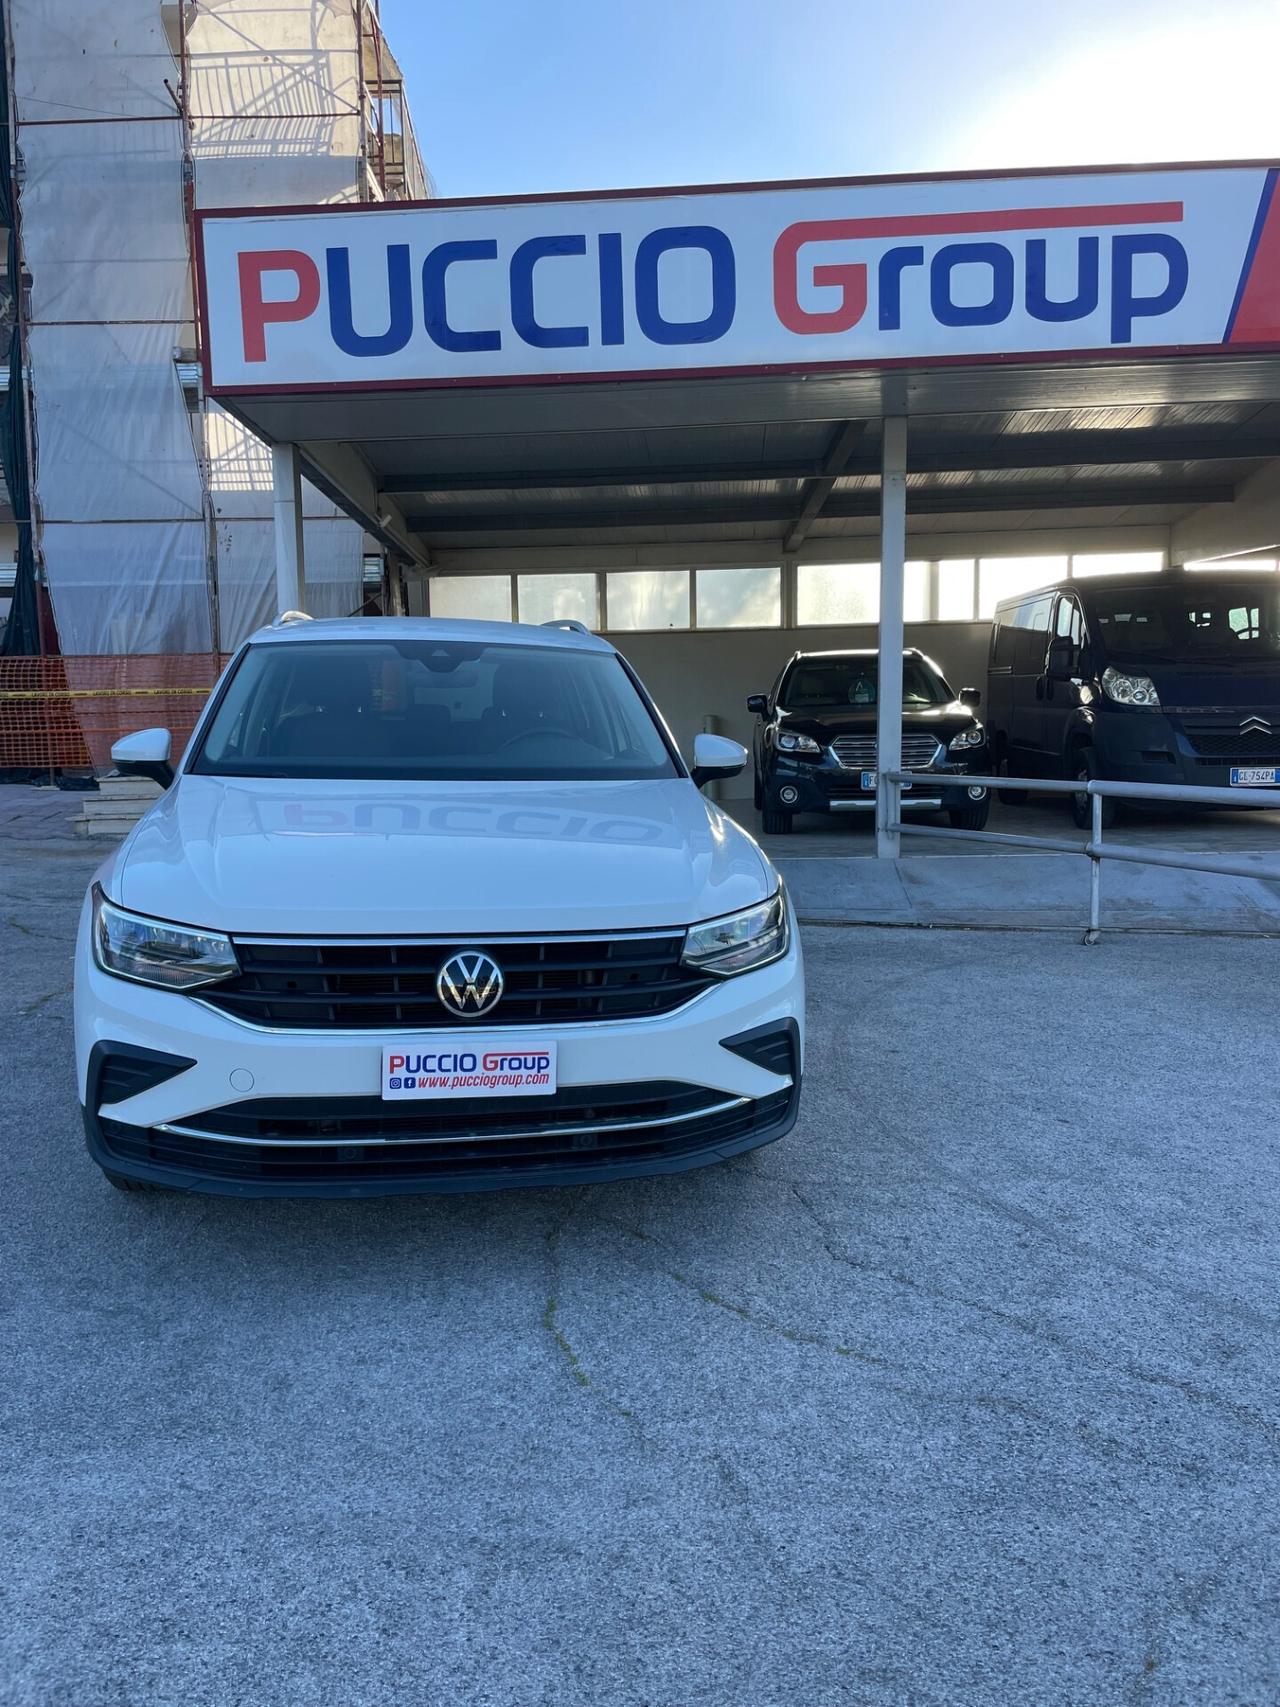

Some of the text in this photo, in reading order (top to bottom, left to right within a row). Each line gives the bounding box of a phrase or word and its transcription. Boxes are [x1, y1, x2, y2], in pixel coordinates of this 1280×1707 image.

[237, 201, 1189, 363] PUCCIO Group
[389, 1052, 550, 1074] PUCCIO Group
[417, 1073, 549, 1090] www.pucciogroup.com
